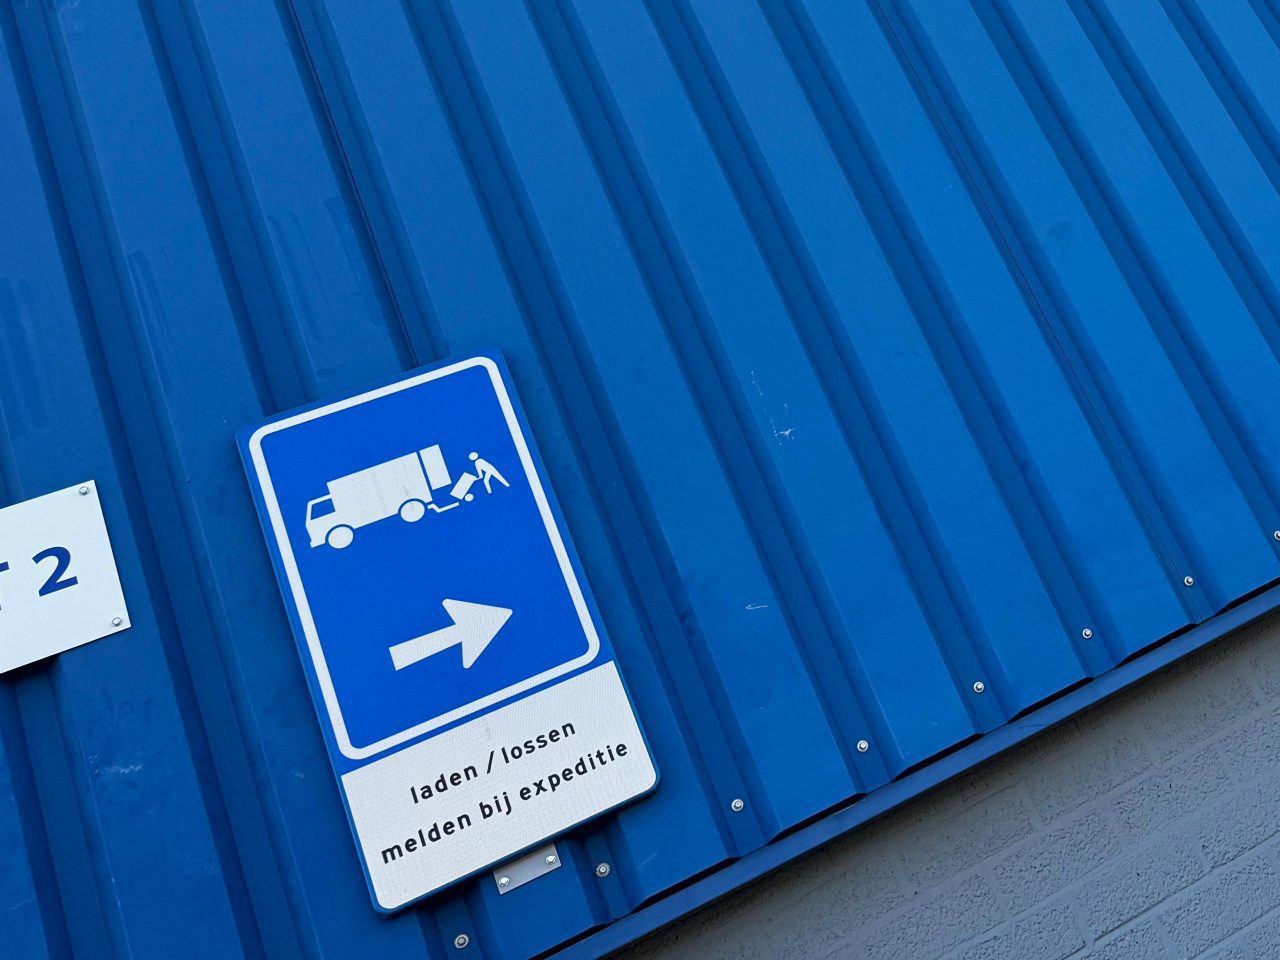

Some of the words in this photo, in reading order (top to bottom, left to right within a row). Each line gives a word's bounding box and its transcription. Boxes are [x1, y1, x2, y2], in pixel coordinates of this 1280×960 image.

[32, 546, 79, 597] 2
[381, 813, 472, 864] melden
[478, 791, 512, 816] bij
[519, 742, 629, 801] expeditie
[410, 765, 478, 804] laden
[501, 722, 576, 764] lossen
